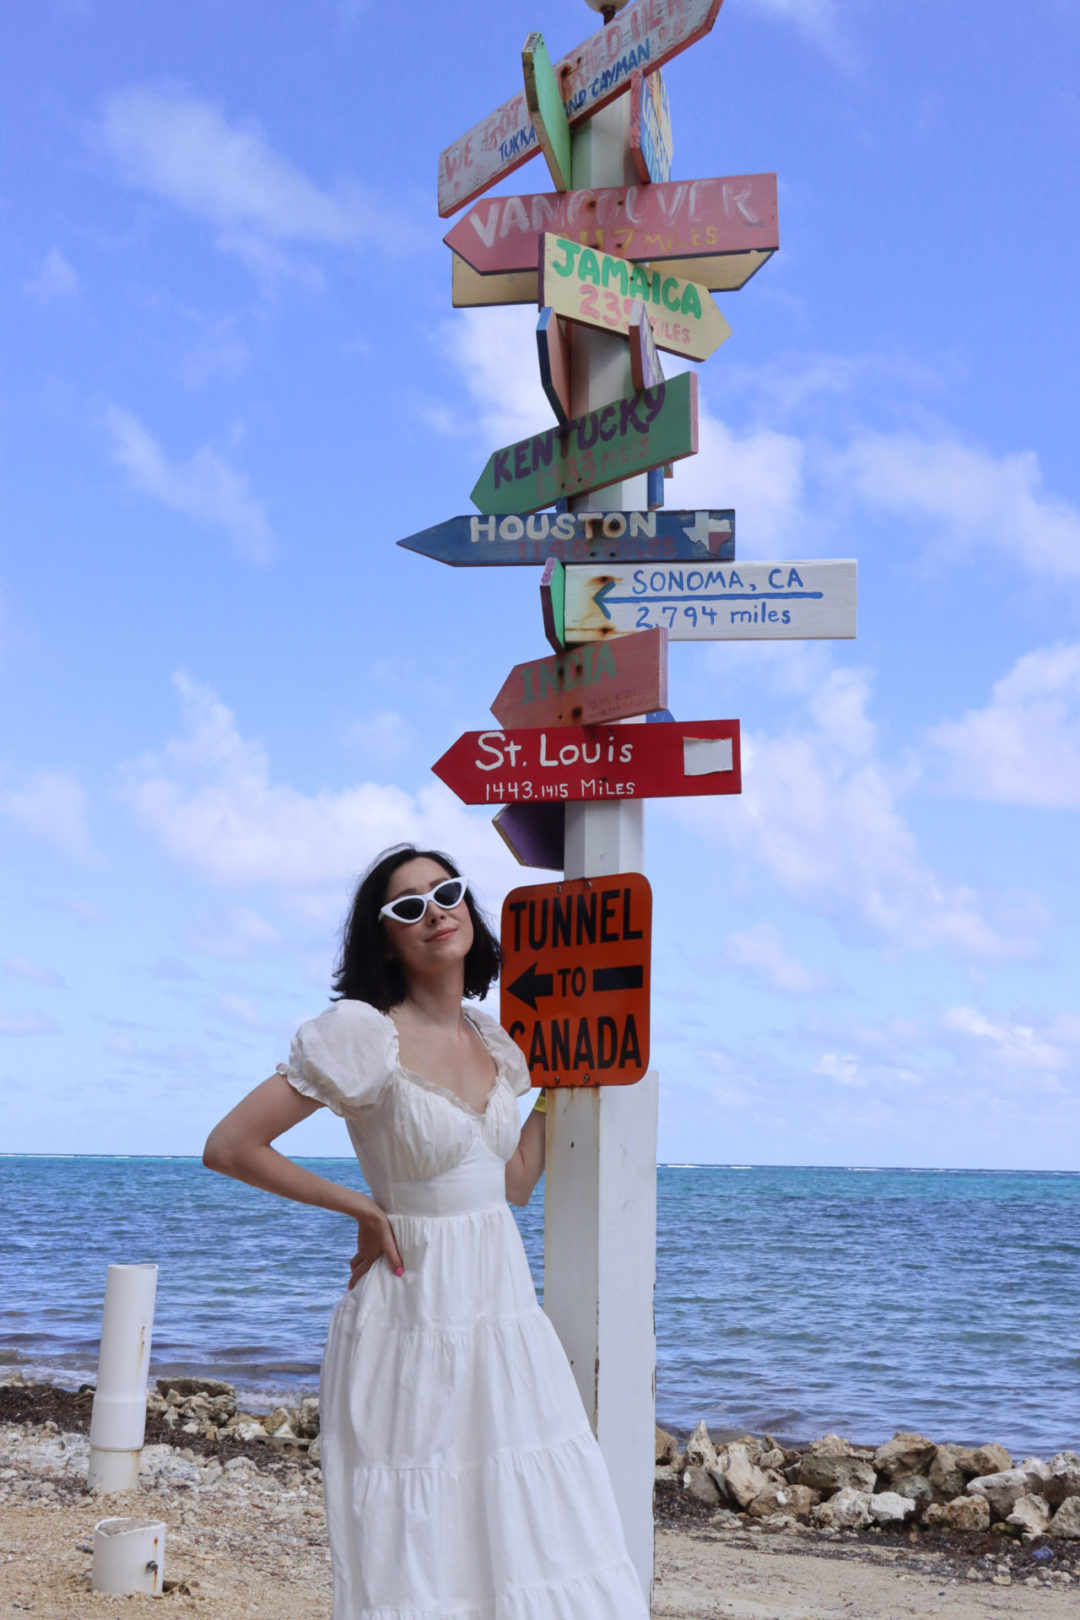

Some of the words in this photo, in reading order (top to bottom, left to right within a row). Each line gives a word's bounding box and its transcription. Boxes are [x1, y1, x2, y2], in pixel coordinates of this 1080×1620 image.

[591, 38, 650, 98] CAYMAN
[469, 180, 759, 248] VANCOUVER
[552, 238, 702, 320] JAMAICA
[494, 383, 666, 490] KENTUCKY
[470, 511, 656, 543] HOUSTON
[768, 567, 804, 589] CA
[730, 601, 792, 625] miles
[520, 642, 617, 705] INDIA
[475, 731, 528, 771] St.
[486, 780, 569, 801] 1443.1415
[509, 887, 644, 952] TUNNEL
[557, 966, 586, 998] TO
